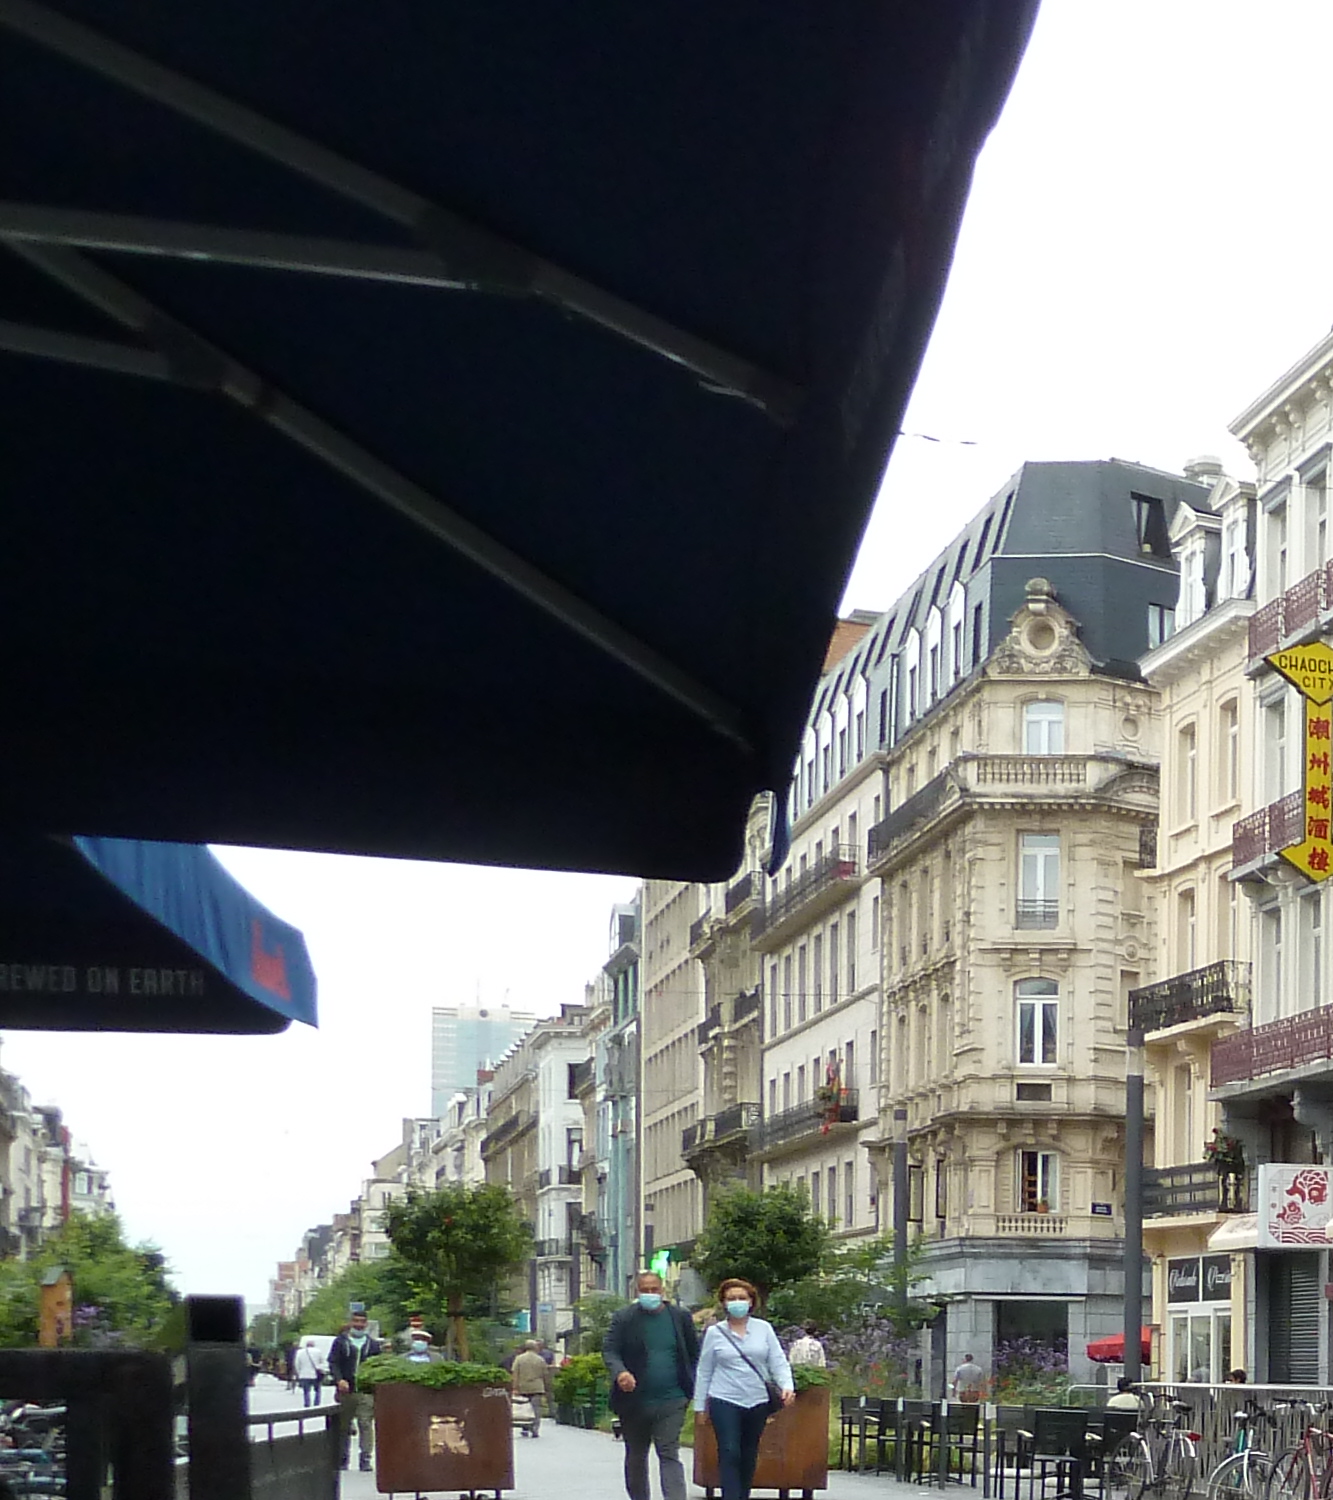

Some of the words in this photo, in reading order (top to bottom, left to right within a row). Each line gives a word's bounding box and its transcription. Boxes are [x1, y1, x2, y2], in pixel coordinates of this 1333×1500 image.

[0, 963, 76, 992] REWED
[86, 967, 119, 993] ON
[129, 968, 204, 995] EARTH
